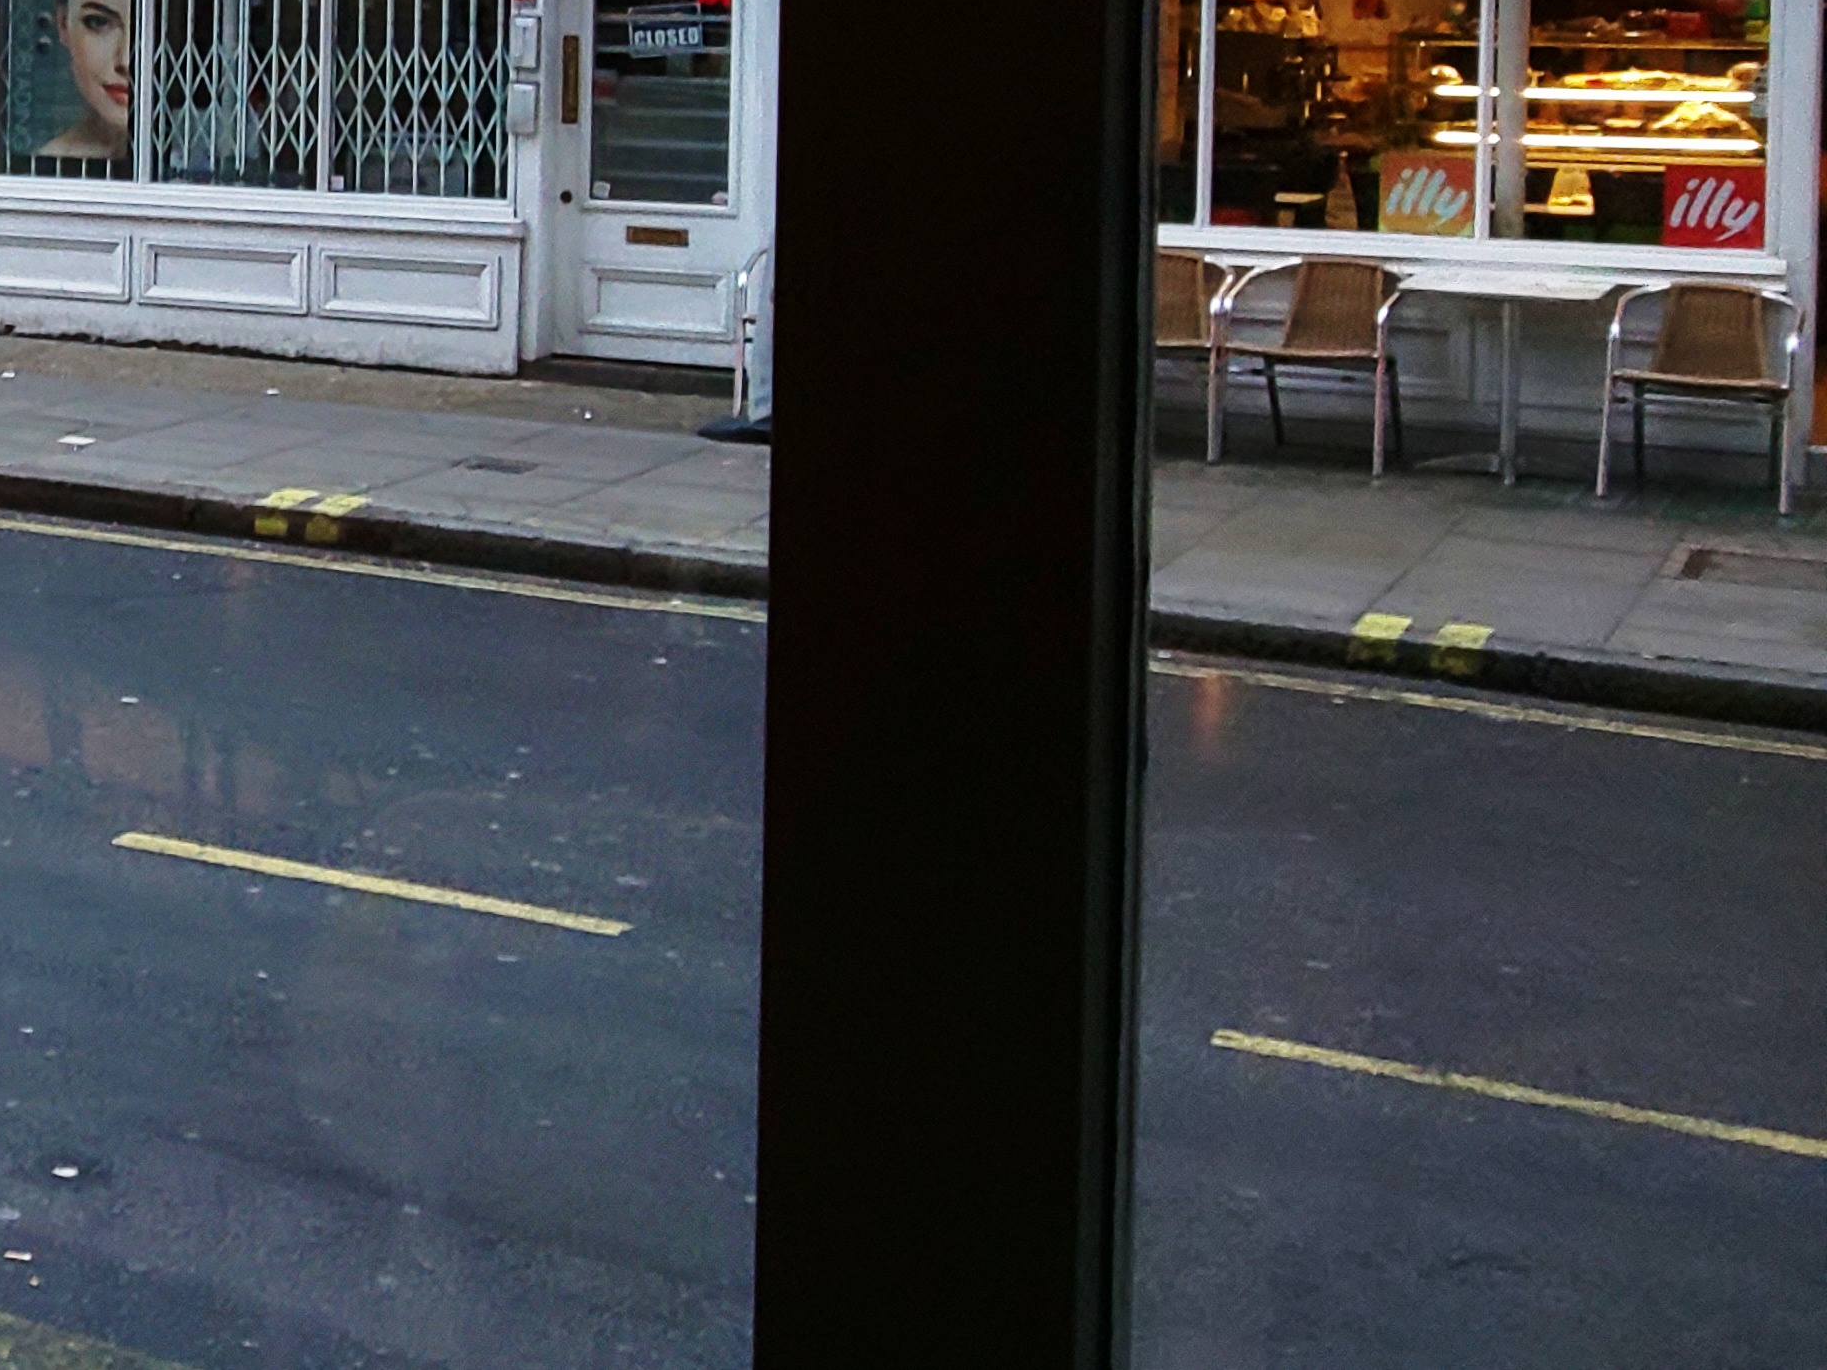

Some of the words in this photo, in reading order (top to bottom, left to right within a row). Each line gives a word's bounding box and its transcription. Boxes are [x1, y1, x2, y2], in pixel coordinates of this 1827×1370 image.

[634, 26, 699, 47] CLOSED
[1385, 166, 1469, 225] illy
[1669, 176, 1760, 242] illy
